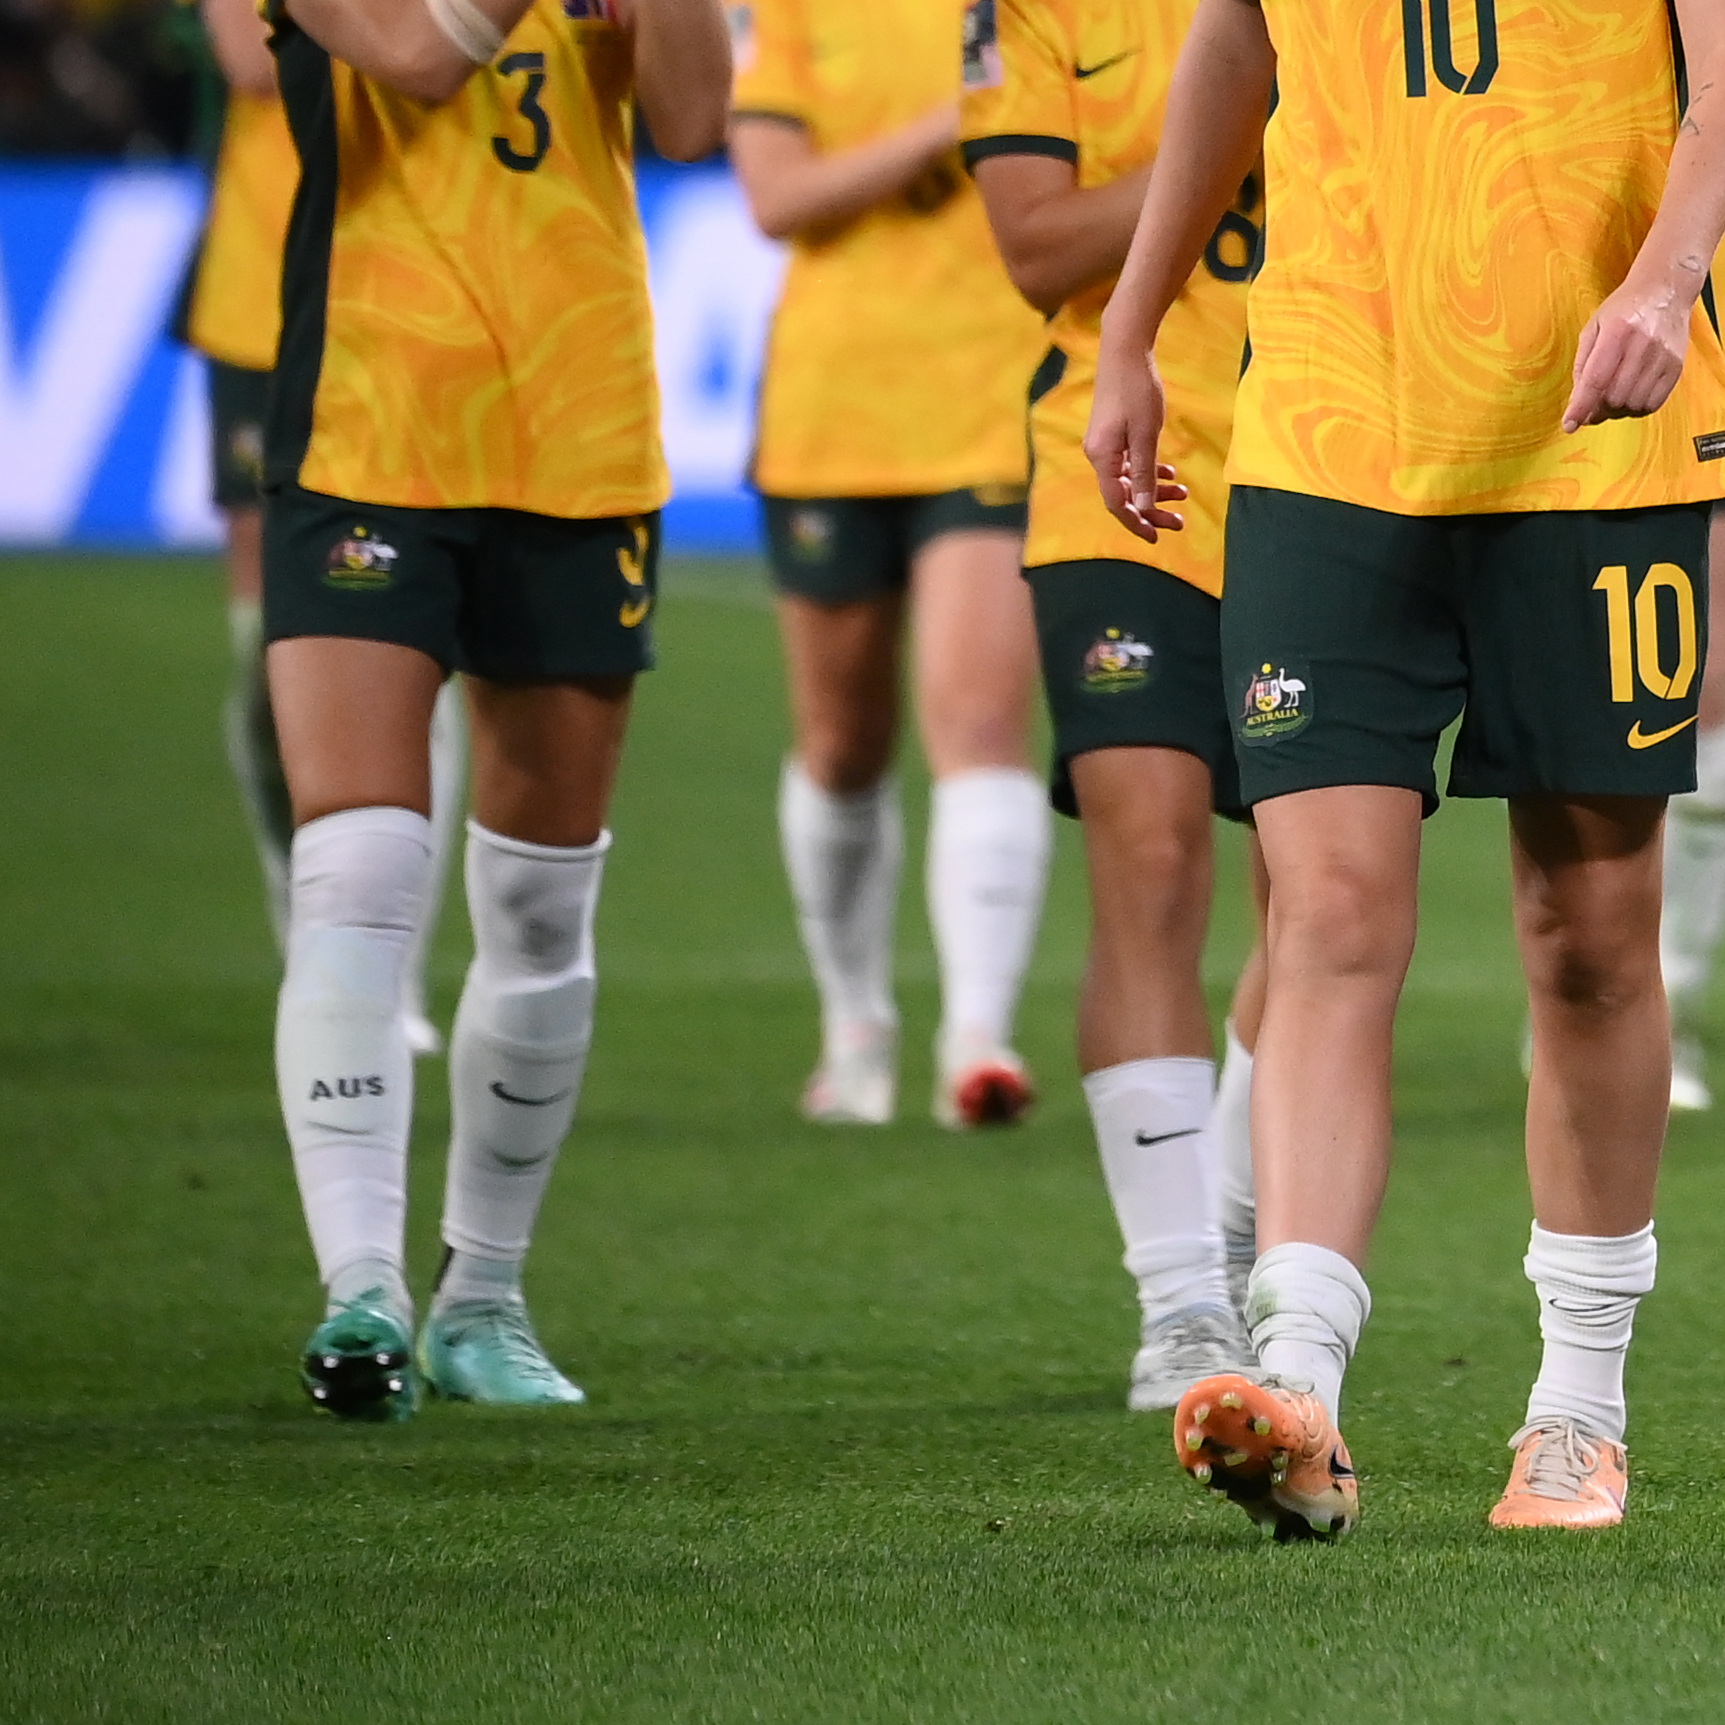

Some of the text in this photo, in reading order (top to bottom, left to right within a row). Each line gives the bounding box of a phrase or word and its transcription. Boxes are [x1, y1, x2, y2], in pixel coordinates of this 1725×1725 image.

[490, 52, 553, 173] 3
[1592, 562, 1698, 703] 10
[311, 1076, 385, 1101] AUS
